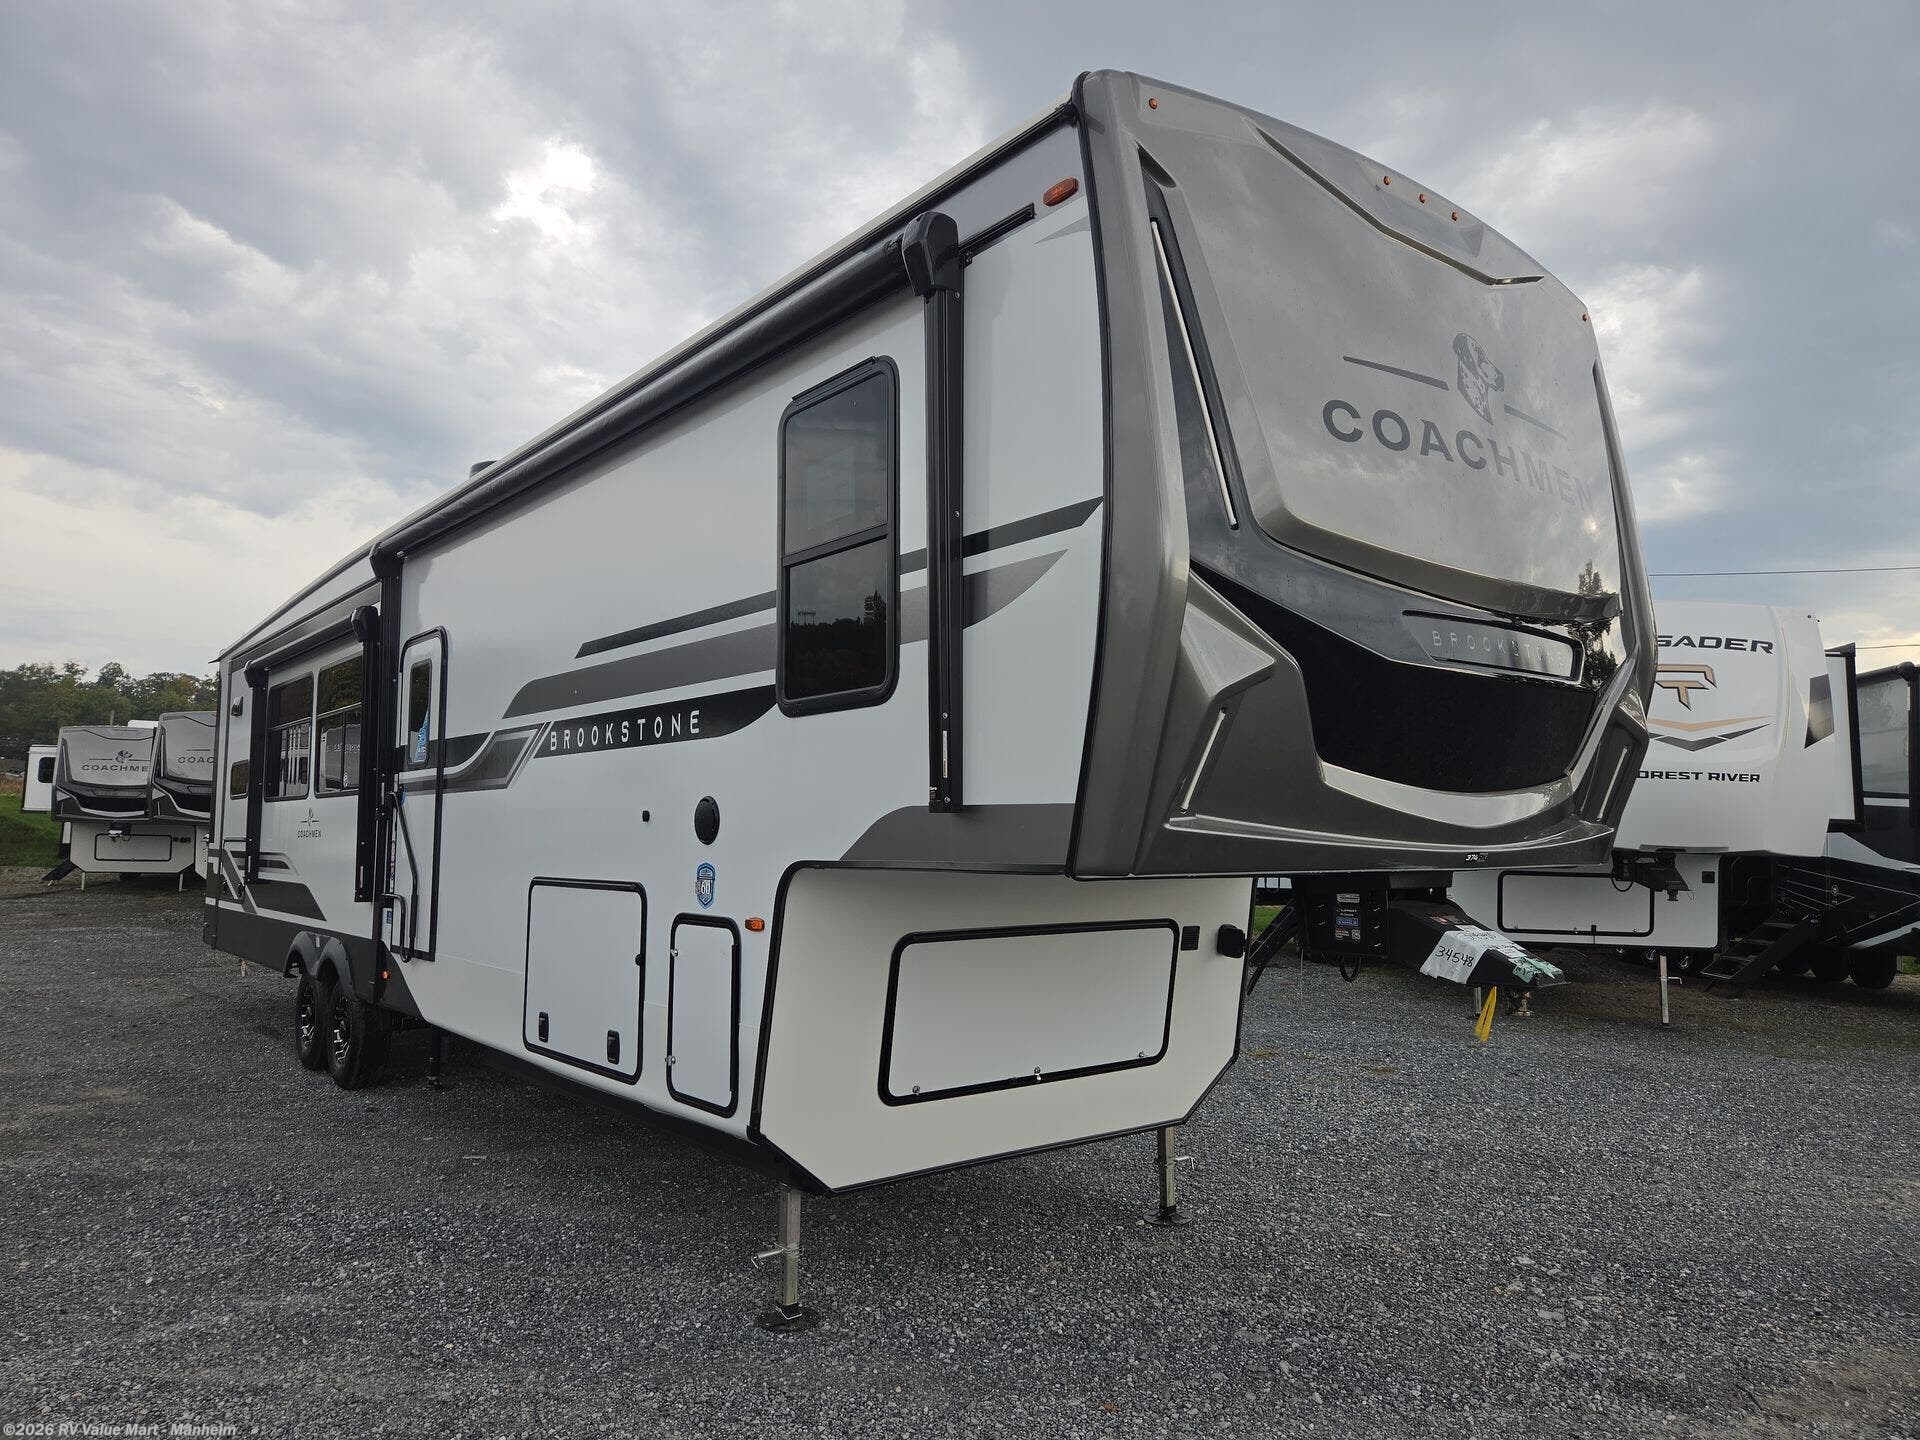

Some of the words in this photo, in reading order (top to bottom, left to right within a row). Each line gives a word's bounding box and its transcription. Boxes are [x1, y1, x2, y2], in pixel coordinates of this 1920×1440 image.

[1322, 399, 1592, 511] COACHMEN
[550, 709, 700, 751] BROOKSTONE
[1708, 772, 1760, 782] RIVER
[1435, 945, 1475, 968] 34548
